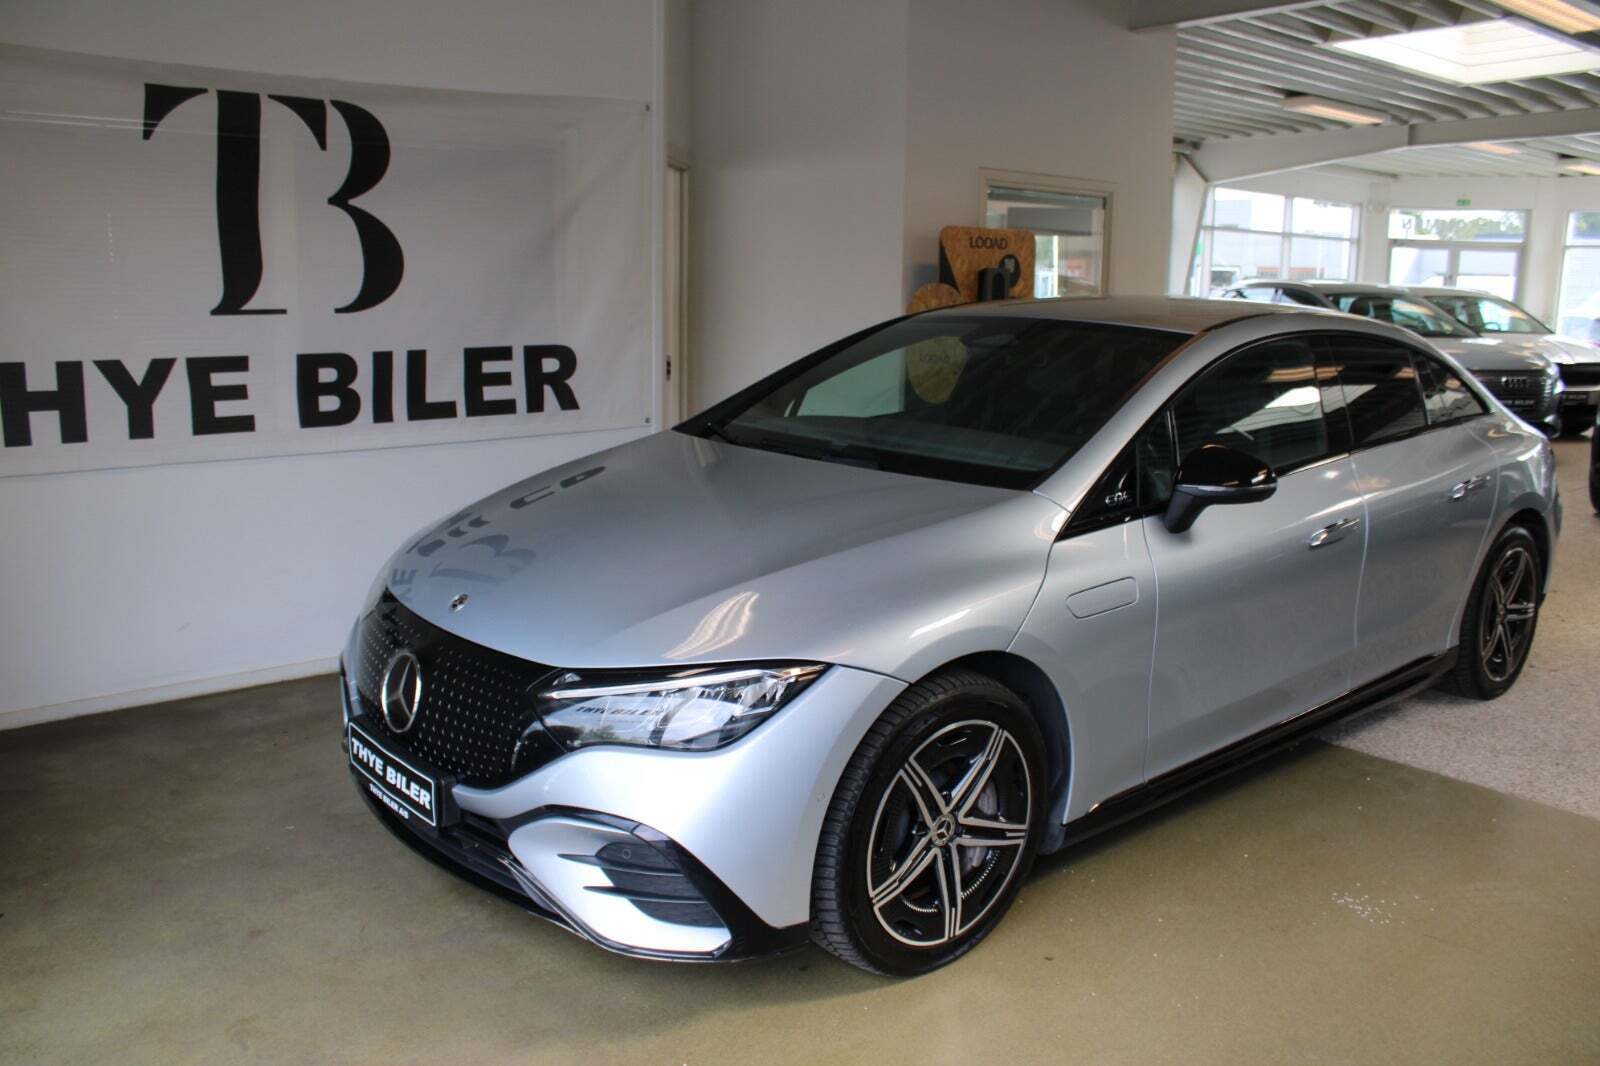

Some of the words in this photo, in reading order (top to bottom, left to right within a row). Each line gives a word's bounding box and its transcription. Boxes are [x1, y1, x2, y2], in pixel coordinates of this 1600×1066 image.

[295, 343, 581, 430] BILER
[351, 737, 384, 776] THYE
[385, 765, 432, 810] BILER
